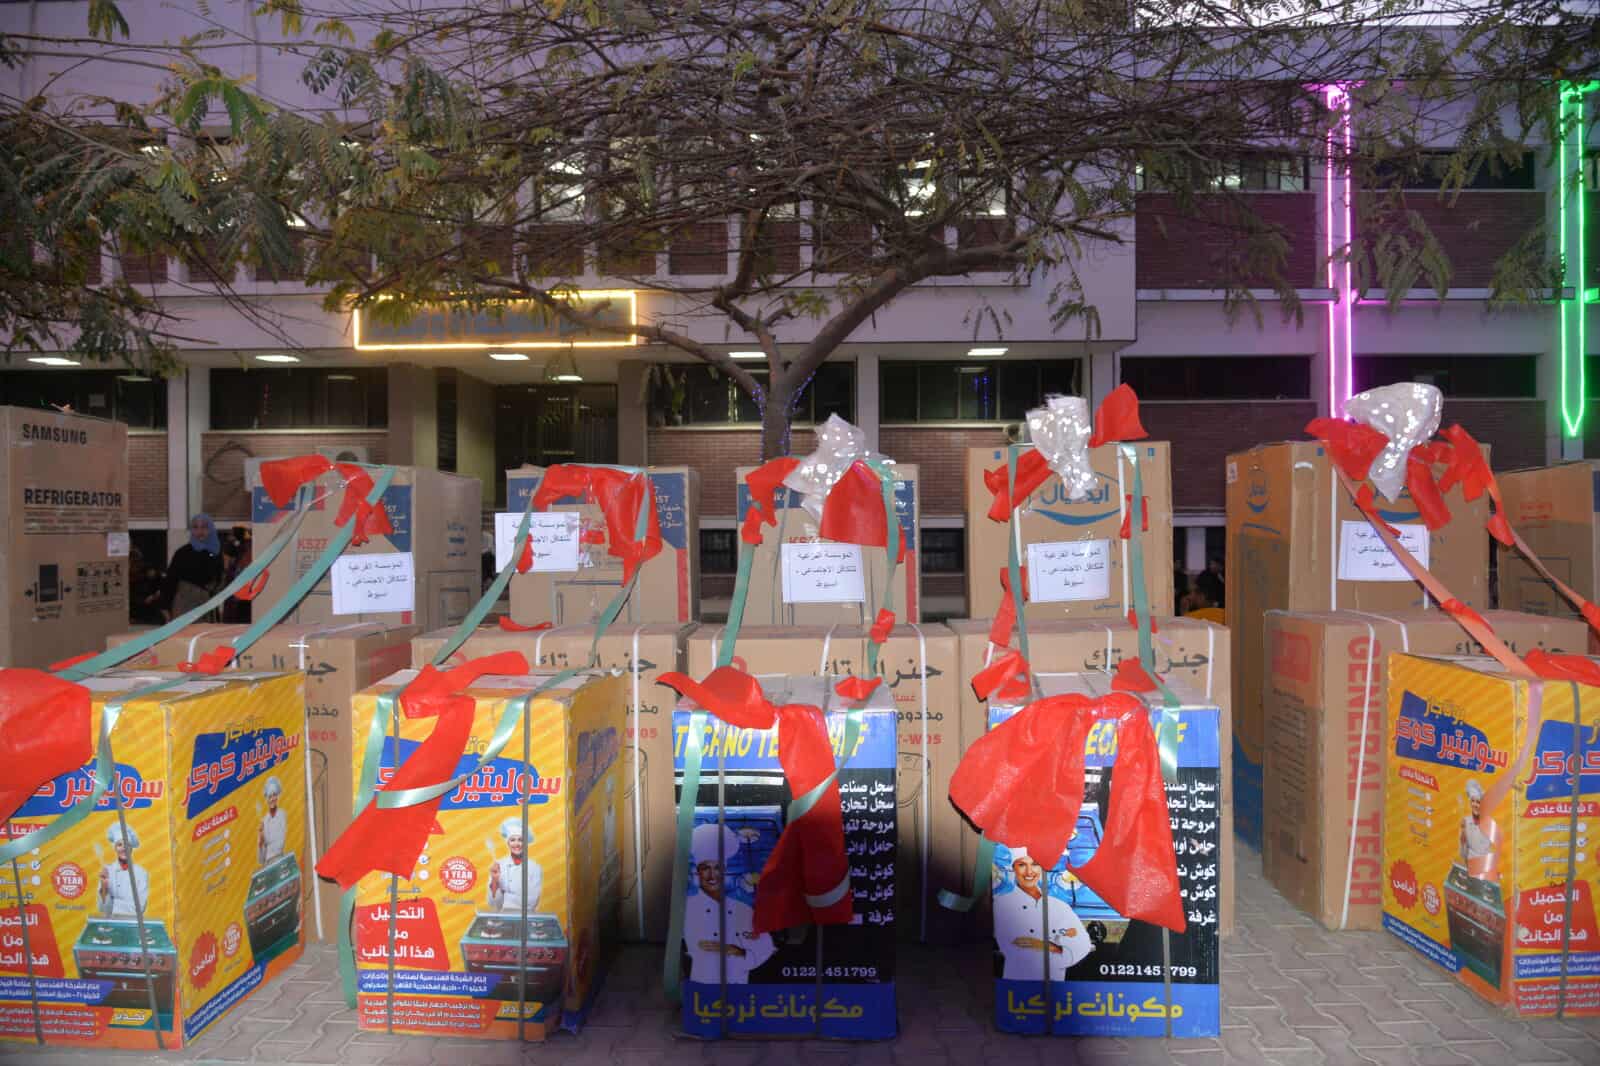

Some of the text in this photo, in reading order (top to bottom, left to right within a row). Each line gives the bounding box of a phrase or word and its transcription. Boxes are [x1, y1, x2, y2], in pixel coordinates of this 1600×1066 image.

[22, 423, 87, 445] SAMSUNG
[24, 487, 122, 507] REFRIGERATOR
[1347, 636, 1381, 801] GENERAL
[869, 780, 894, 796] سجل
[1189, 780, 1216, 796] سجل
[869, 796, 895, 813] سجل
[1189, 796, 1216, 813] سجل
[861, 819, 895, 834] مروحة
[1181, 818, 1216, 834] مروحة
[1347, 812, 1382, 906] TECH
[1188, 909, 1217, 927] غرفة
[1543, 911, 1564, 924] من
[3, 933, 24, 948] من
[781, 966, 878, 978] 0122451799
[1099, 965, 1198, 977] 0122145799
[1077, 992, 1184, 1023] مكونات
